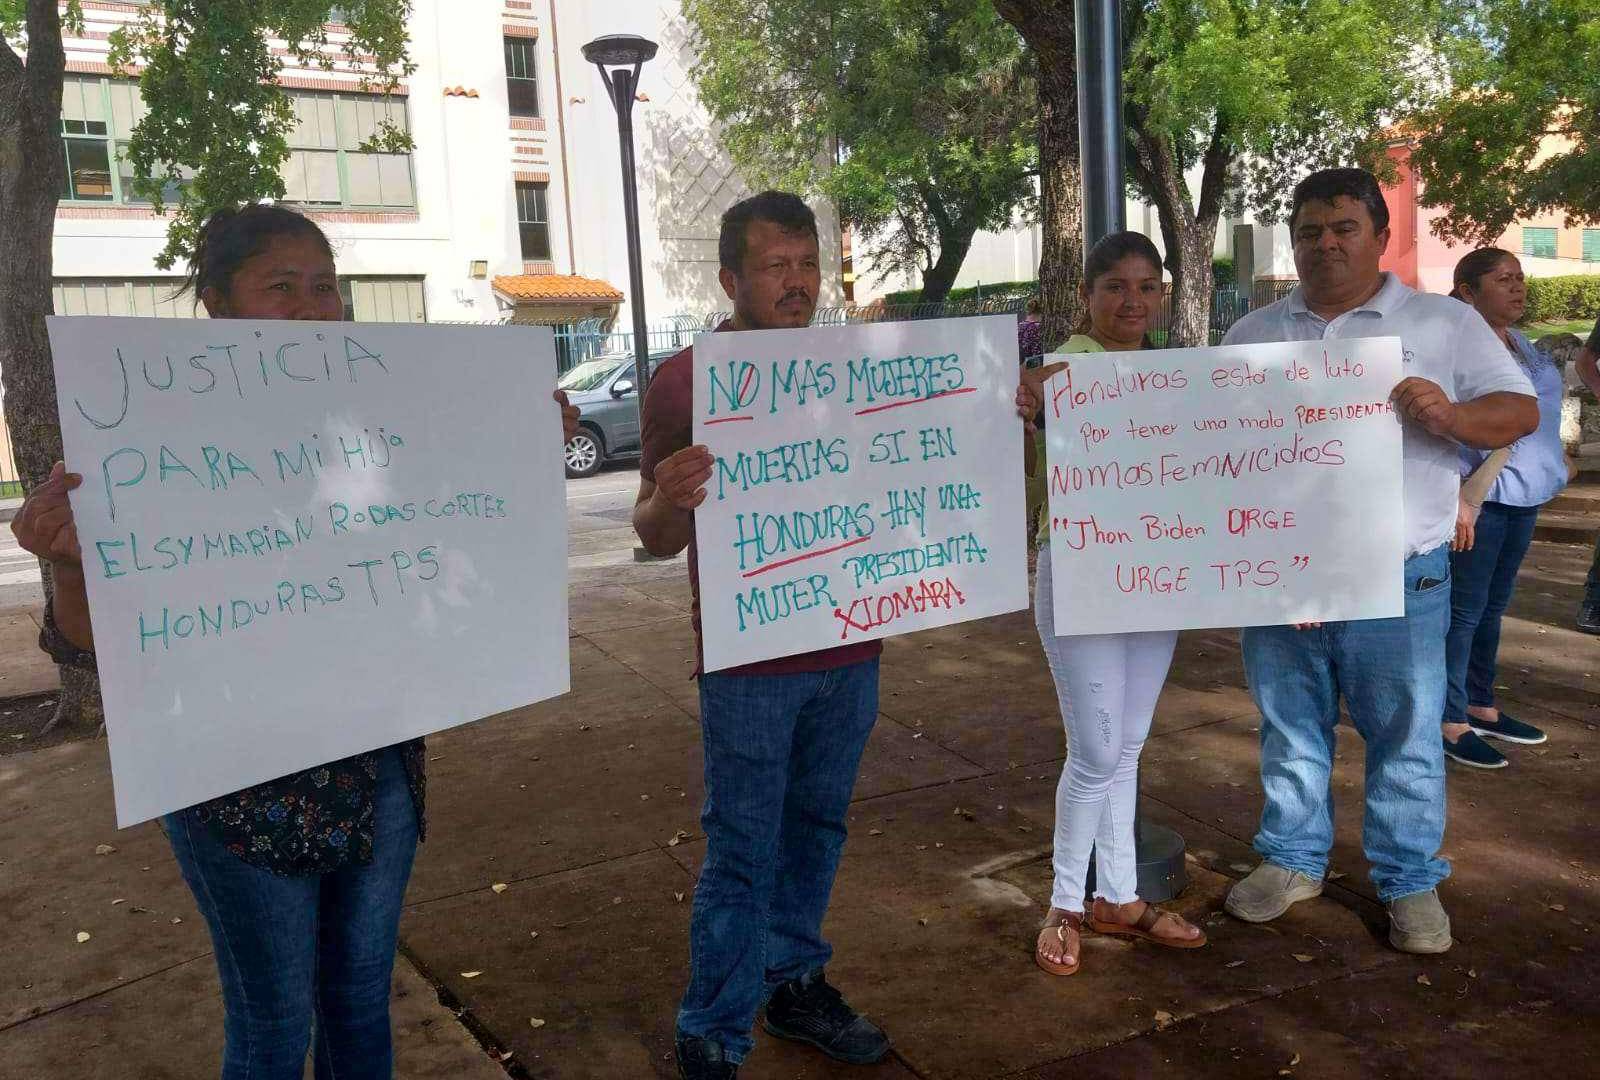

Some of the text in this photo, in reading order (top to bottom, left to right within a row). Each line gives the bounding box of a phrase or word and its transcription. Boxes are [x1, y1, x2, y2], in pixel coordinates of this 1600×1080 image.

[706, 353, 964, 414] NO MAS MUJERES
[1051, 365, 1188, 418] Honduras
[1286, 359, 1310, 382] de
[1324, 350, 1366, 379] luto
[1126, 418, 1178, 441] tener
[1194, 417, 1228, 432] una
[1238, 409, 1285, 430] mala
[1294, 400, 1393, 429] PRESIDENTA
[101, 444, 264, 524] PARA
[716, 426, 957, 500] MUERTAS SI EN
[733, 483, 982, 571] HONDURAS HAY UNA
[1139, 512, 1207, 541] Biden
[347, 546, 441, 606] TPS
[736, 573, 838, 632] MUJER
[1115, 563, 1192, 593] URGE
[832, 576, 967, 641] XIOMARA
